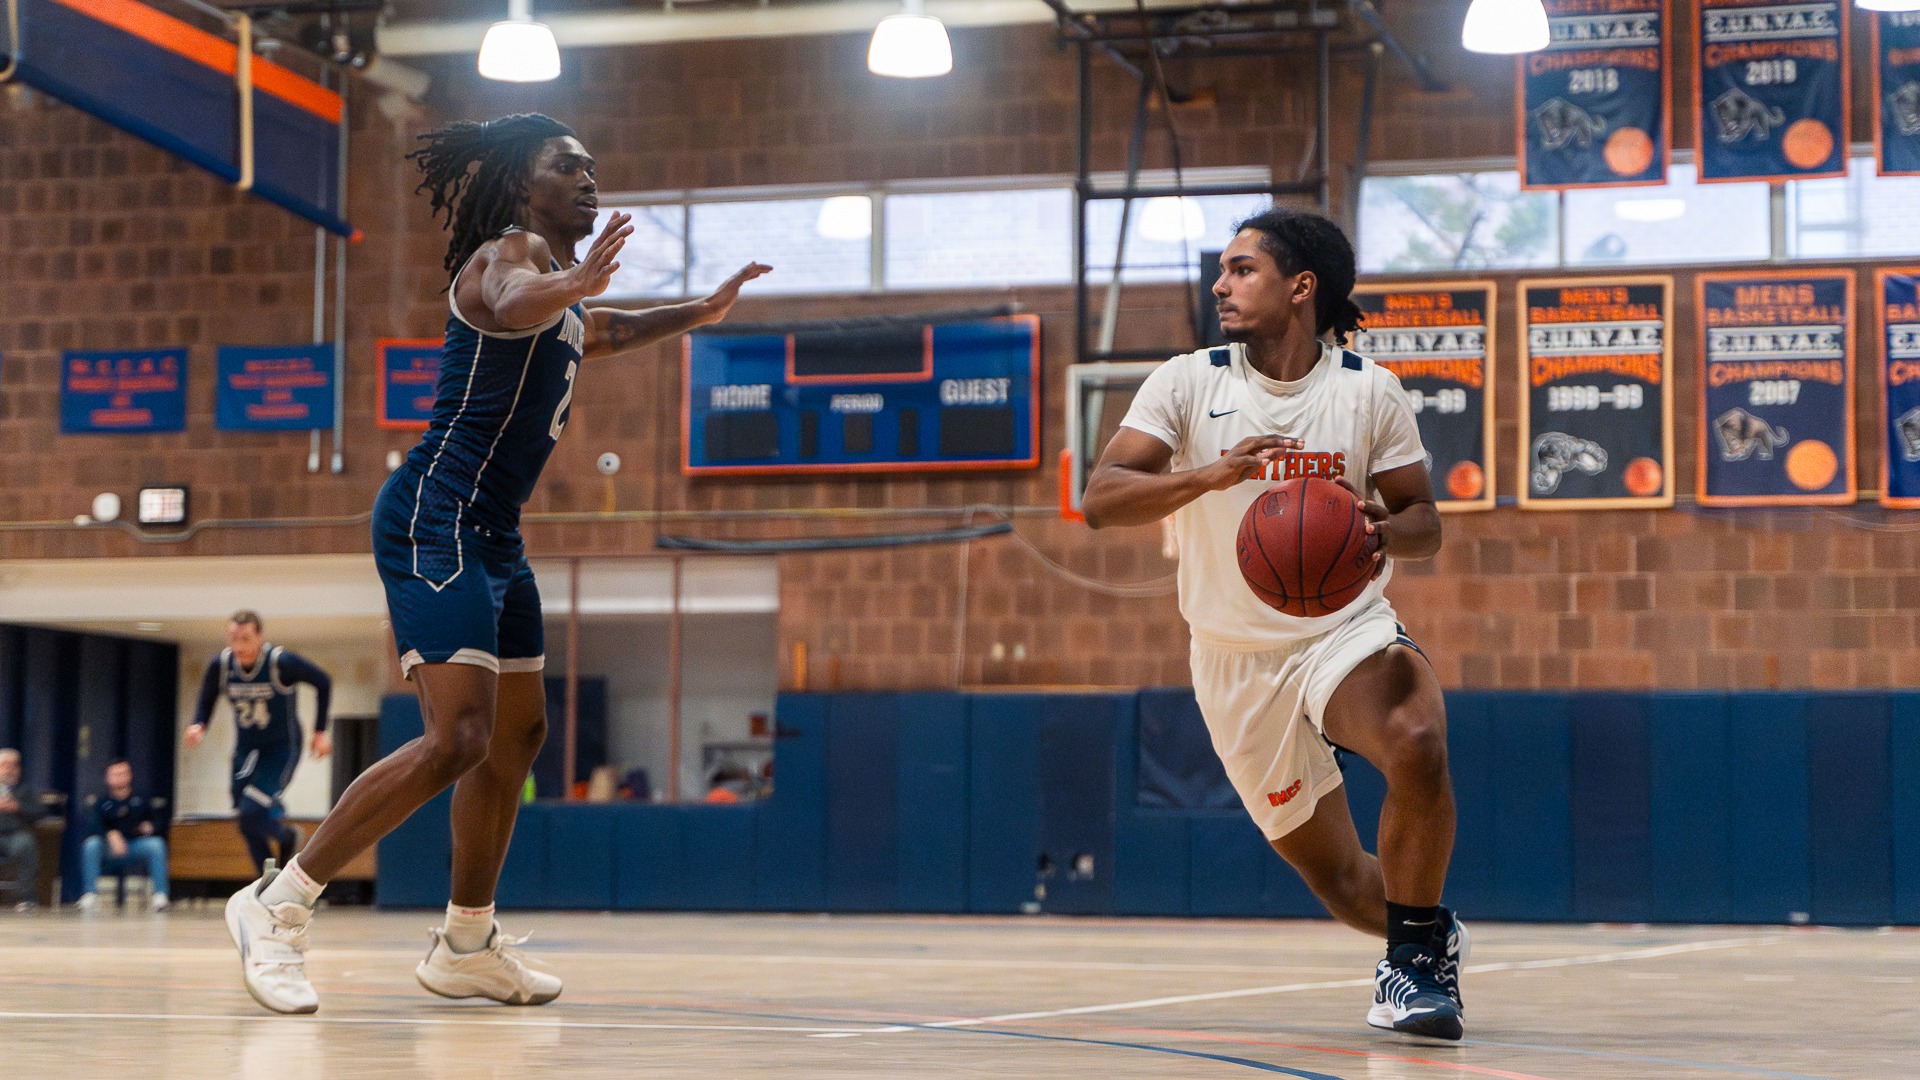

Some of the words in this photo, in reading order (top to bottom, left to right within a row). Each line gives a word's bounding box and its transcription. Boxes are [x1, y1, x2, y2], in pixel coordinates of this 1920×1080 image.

[1704, 38, 1838, 68] CHAMPIONS
[1529, 304, 1661, 323] BASKETBALL
[1706, 306, 1845, 324] BASKETBALL
[1531, 354, 1661, 387] CHAMPIONS
[1708, 361, 1843, 387] CHAMPIONS
[710, 384, 772, 409] HOME
[940, 378, 1011, 406] GUEST
[1748, 380, 1801, 405] 2007
